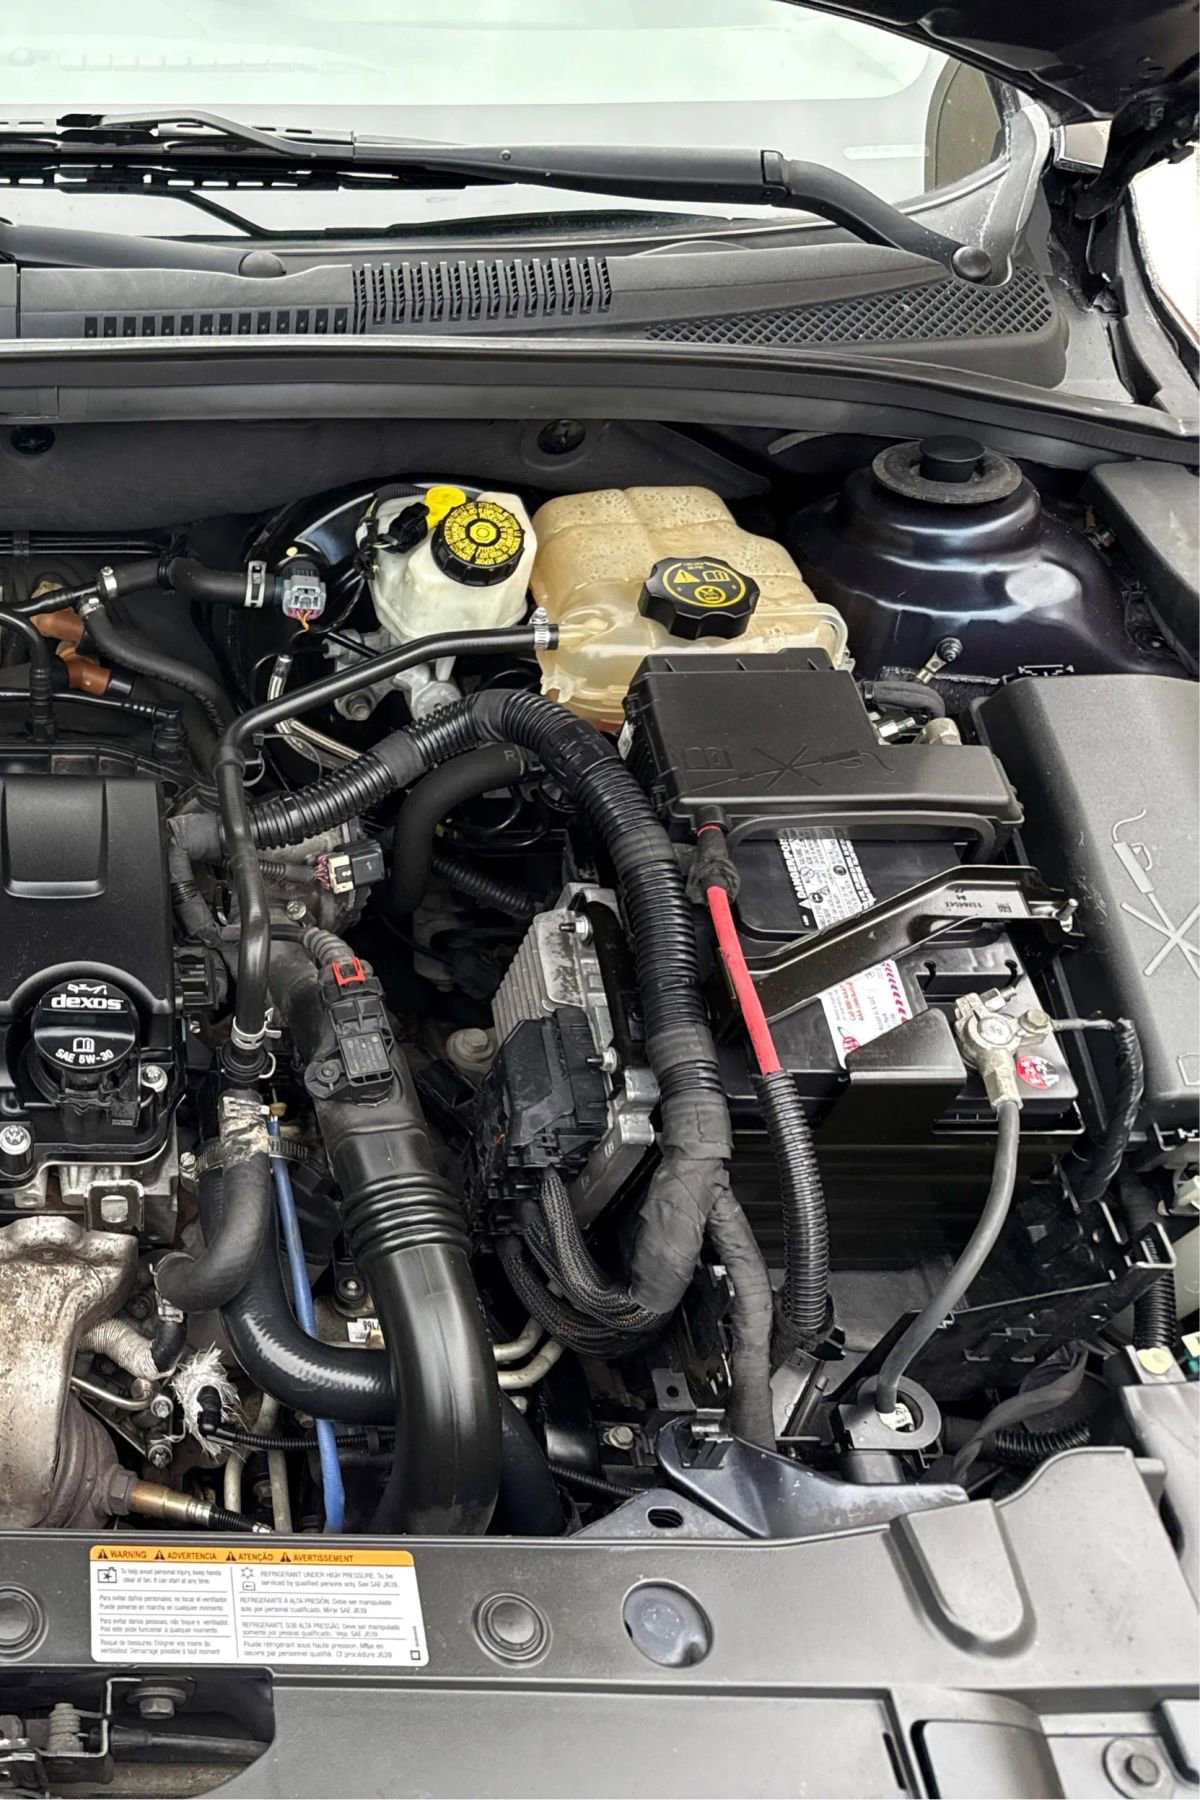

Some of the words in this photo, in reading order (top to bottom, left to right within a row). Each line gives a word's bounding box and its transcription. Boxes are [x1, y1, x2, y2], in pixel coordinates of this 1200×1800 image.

[51, 994, 124, 1010] dexos
[55, 1048, 75, 1064] SAE
[78, 1049, 114, 1065] 5W-30
[110, 1550, 147, 1559] WARNING
[167, 1551, 217, 1560] ADVERTENCIA
[238, 1553, 273, 1562] ATENÇÃO
[293, 1554, 353, 1562] AVERTISSEMENT
